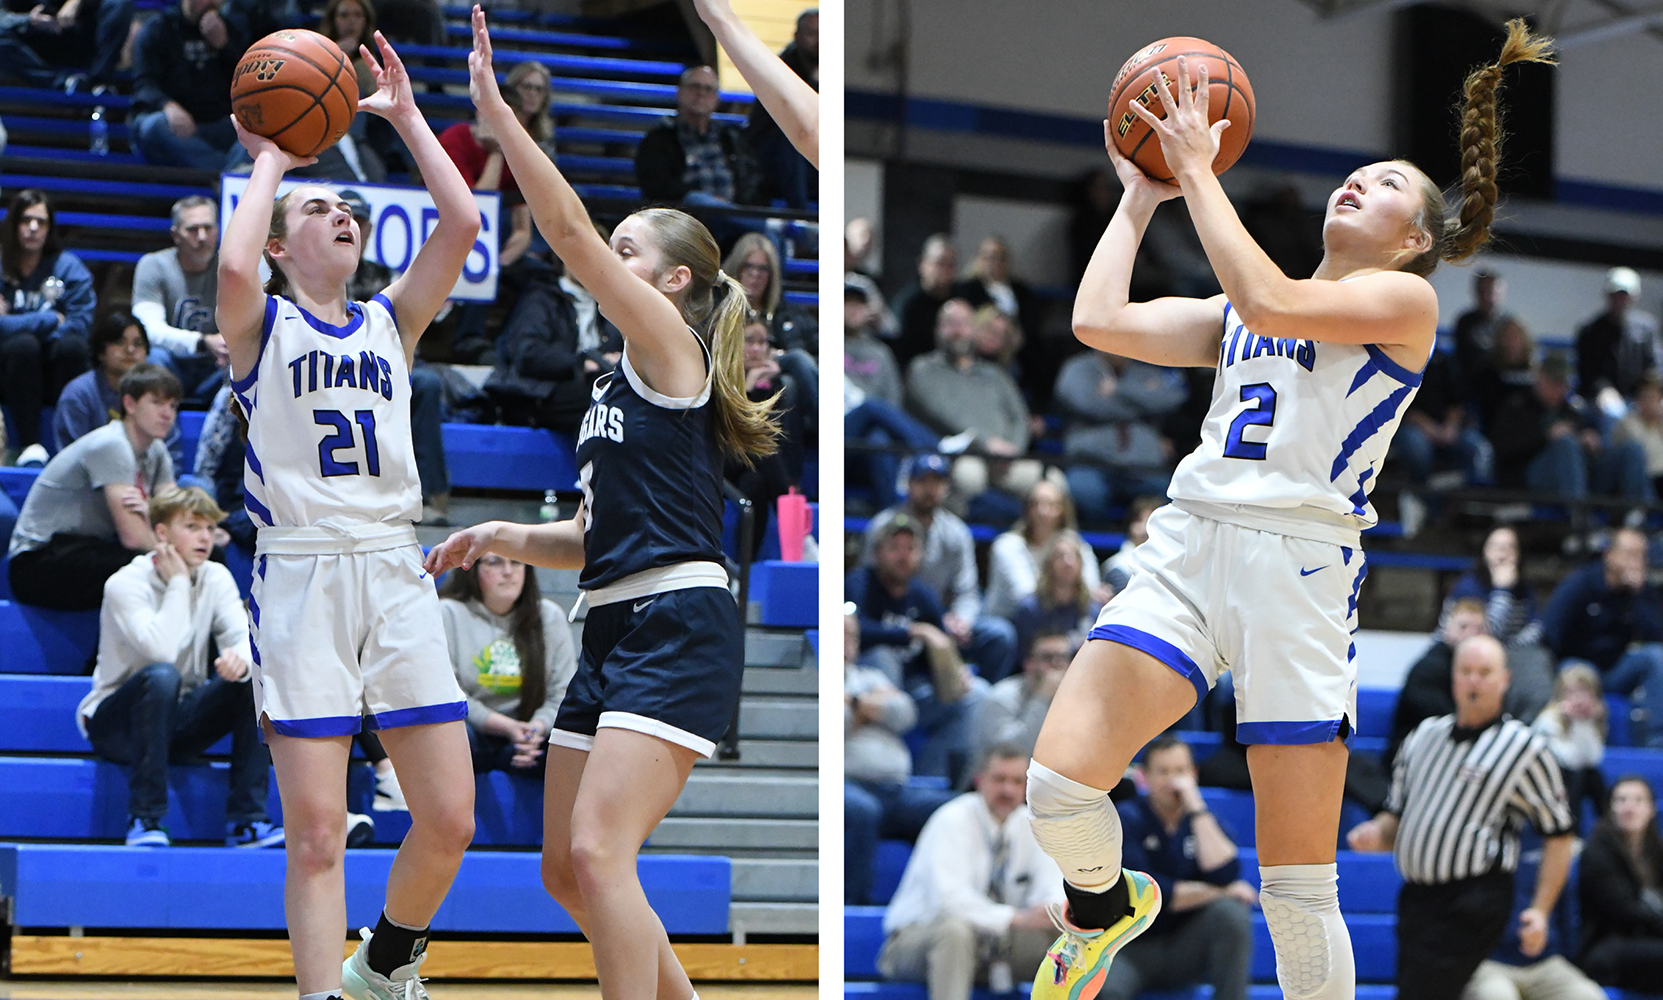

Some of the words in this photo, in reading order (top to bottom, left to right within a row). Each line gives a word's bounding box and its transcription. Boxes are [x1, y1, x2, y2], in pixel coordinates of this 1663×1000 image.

[1117, 71, 1173, 140] ELTE
[288, 350, 393, 402] TITANS
[312, 409, 381, 478] 21
[1222, 381, 1277, 461] 2
